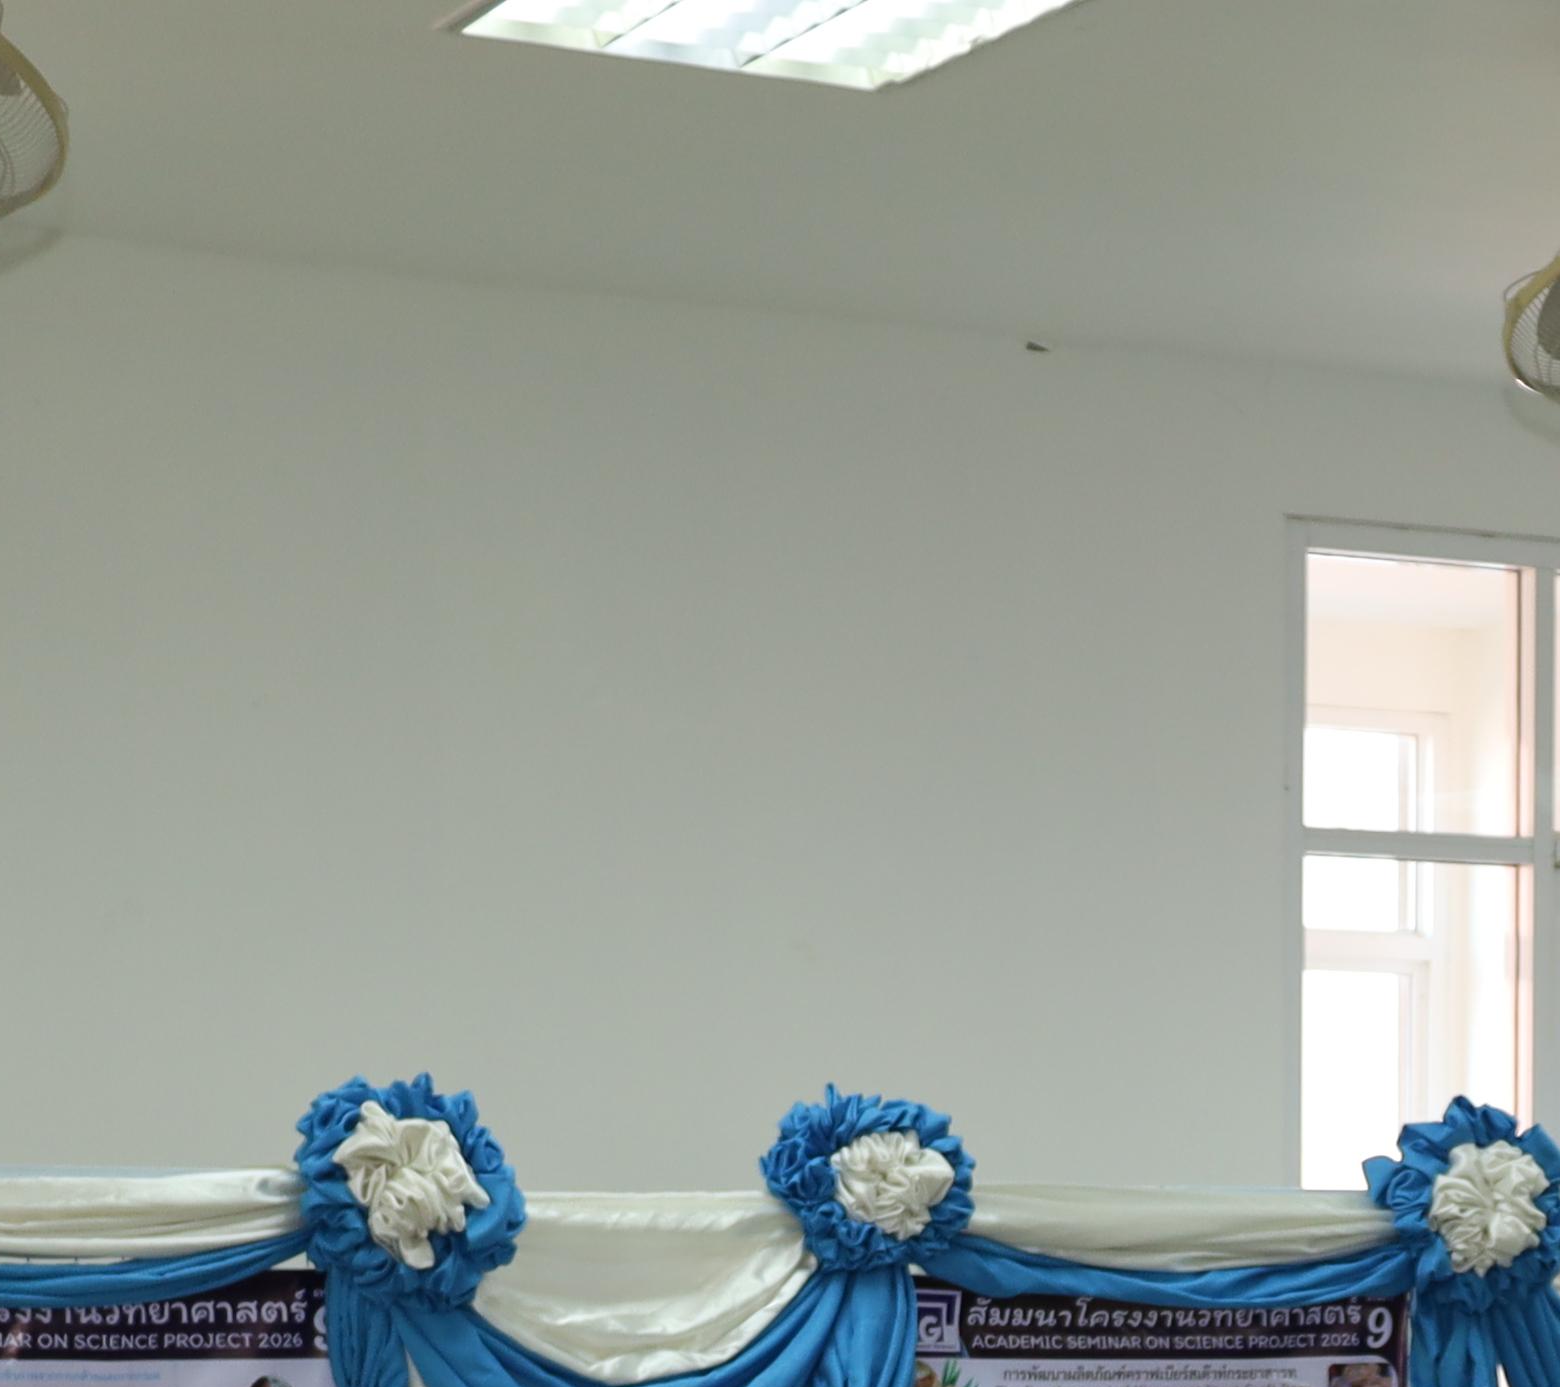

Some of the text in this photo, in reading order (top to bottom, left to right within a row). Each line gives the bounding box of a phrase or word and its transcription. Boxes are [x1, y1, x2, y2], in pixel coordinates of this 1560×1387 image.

[1366, 1306, 1393, 1349] 9
[37, 1333, 69, 1349] ON
[74, 1333, 158, 1350] SCIENCE
[163, 1332, 253, 1349] PROJECT
[258, 1332, 303, 1348] 2026
[972, 1333, 1360, 1350] ACADEMIC SEMINAR ON SCIENCE PROJECT 2026
